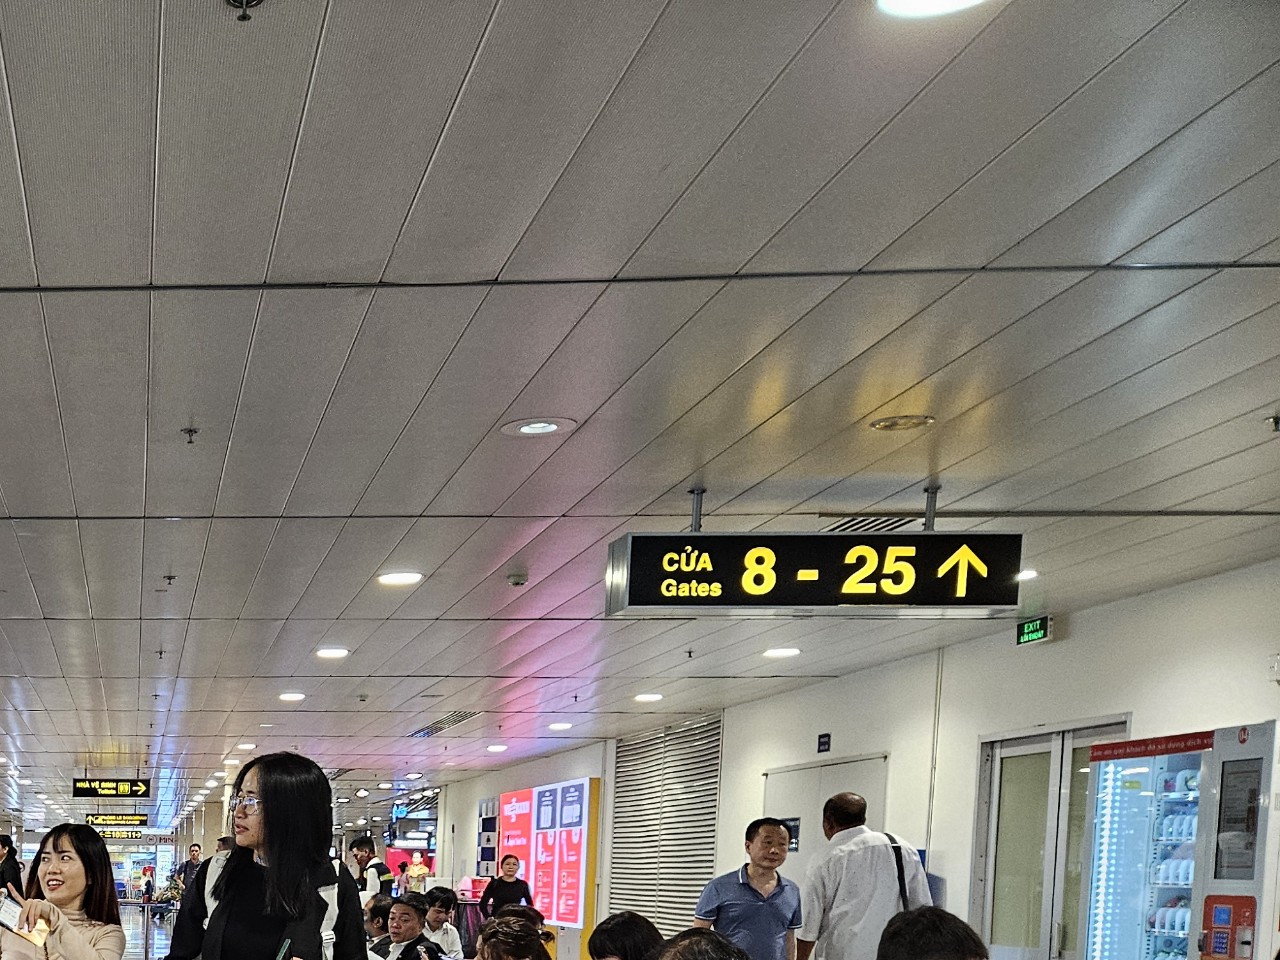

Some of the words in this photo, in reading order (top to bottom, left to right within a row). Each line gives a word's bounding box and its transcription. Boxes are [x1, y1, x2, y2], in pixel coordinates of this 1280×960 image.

[662, 546, 713, 572] CỬA
[741, 547, 777, 595] 8
[841, 545, 916, 595] 25
[661, 579, 722, 597] Gates
[1024, 620, 1040, 632] EXIT
